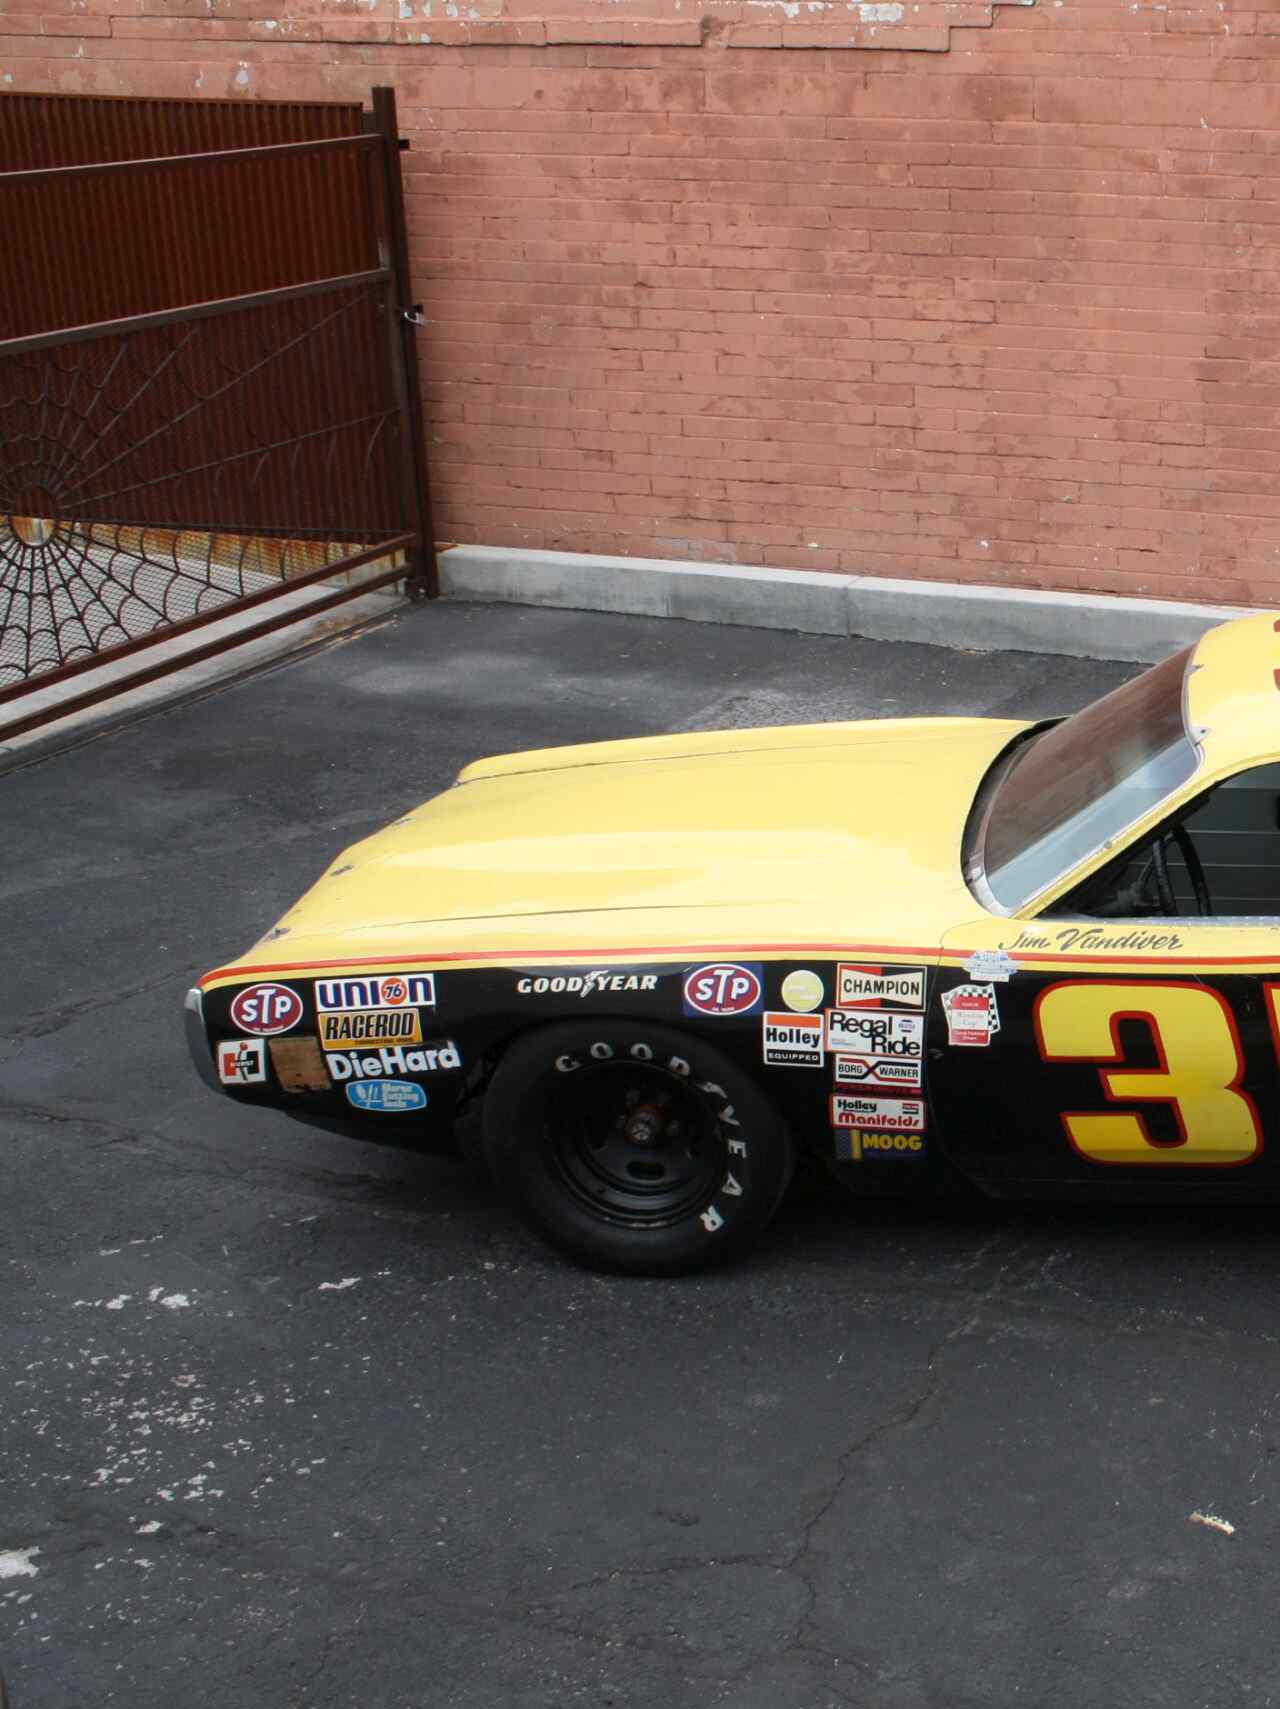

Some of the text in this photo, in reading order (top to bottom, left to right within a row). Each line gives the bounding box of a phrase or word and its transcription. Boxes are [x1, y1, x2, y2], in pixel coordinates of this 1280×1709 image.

[998, 928, 1184, 952] Jim Vandiver
[384, 984, 403, 998] 76
[517, 969, 658, 998] GOODYEAR
[695, 969, 749, 1004] STP
[843, 979, 920, 995] CHAMPION
[240, 988, 292, 1024] STP
[325, 1012, 415, 1040] RACEROD
[830, 1012, 893, 1039] Regal
[766, 1027, 821, 1048] Holley
[871, 1035, 921, 1057] Ride
[326, 1040, 461, 1080] DieHard
[768, 1053, 819, 1062] EQUIPPED
[838, 1064, 919, 1078] BORG WARNER
[837, 1099, 877, 1113] Holley
[838, 1112, 919, 1127] Manifolds
[862, 1134, 922, 1151] MOOG
